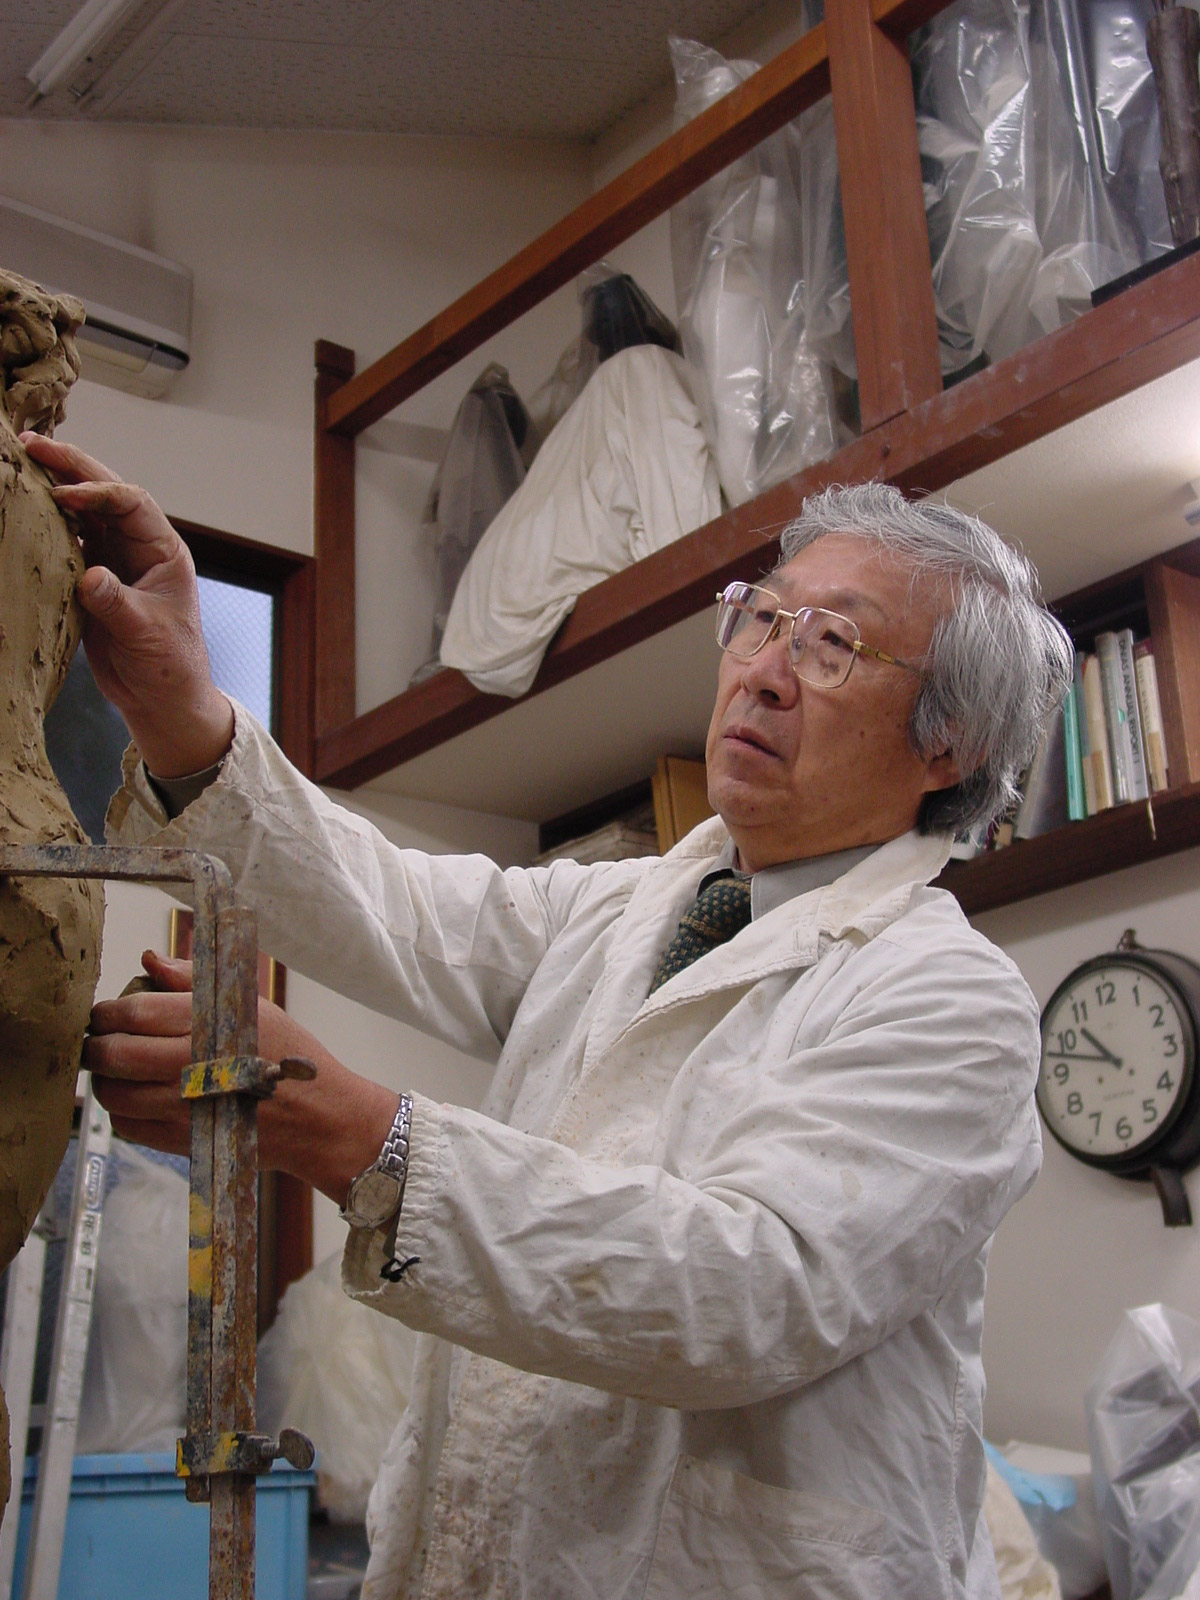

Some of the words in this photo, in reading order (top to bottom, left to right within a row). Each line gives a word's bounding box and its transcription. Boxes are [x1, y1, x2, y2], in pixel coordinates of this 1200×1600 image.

[1123, 674, 1134, 717] ANNUAL
[1128, 718, 1139, 757] REPORT
[1095, 981, 1116, 1006] 12
[1132, 984, 1140, 1007] 1
[1071, 1000, 1088, 1024] 11
[1149, 1004, 1165, 1028] 2
[1057, 1029, 1077, 1054] 10
[1163, 1033, 1178, 1057] 3
[1053, 1063, 1070, 1085] 9
[1157, 1070, 1174, 1093] 4
[1067, 1091, 1083, 1115] 8
[1142, 1098, 1158, 1123] 5
[1089, 1112, 1102, 1136] 7
[1115, 1117, 1133, 1140] 6
